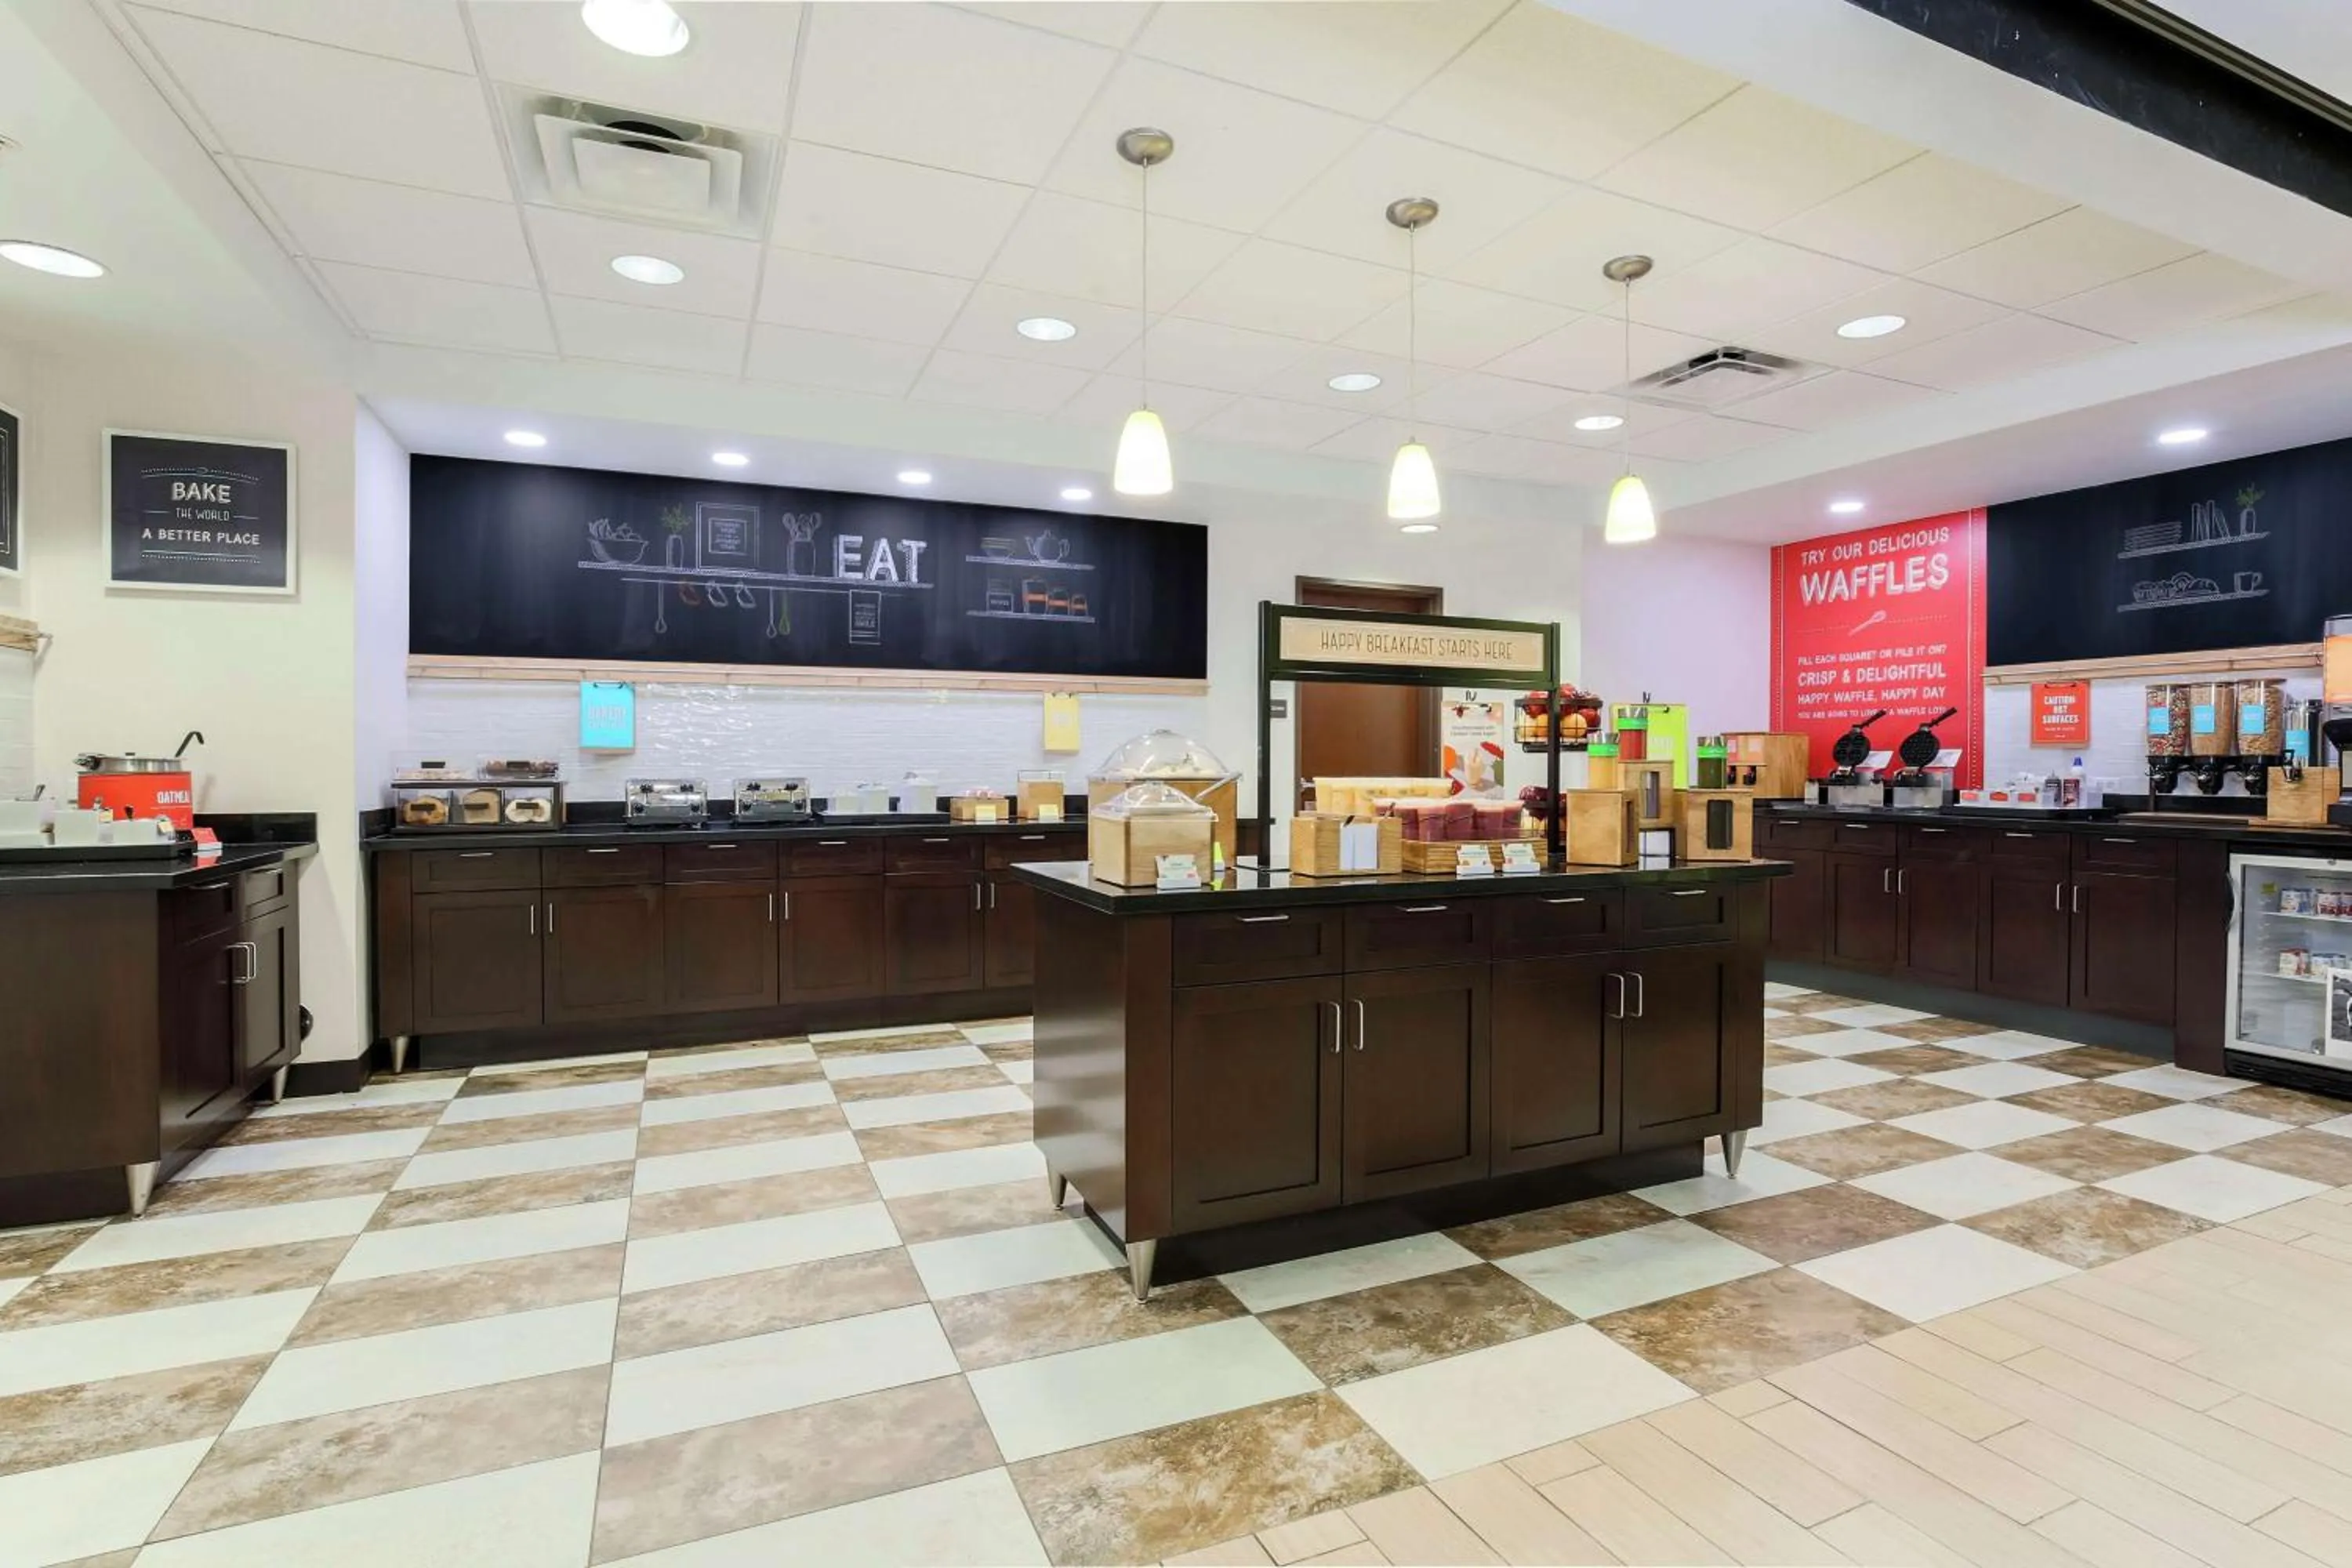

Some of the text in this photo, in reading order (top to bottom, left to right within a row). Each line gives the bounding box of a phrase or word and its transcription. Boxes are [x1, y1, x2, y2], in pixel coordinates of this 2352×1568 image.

[171, 481, 232, 504] BAKE
[176, 507, 230, 521] THE WORLD
[142, 528, 260, 545] A BETTER PLACE
[1801, 527, 1950, 566] TRY OUR DELICIOUS
[833, 534, 927, 584] EAT
[1799, 553, 1950, 607] WAFFLES
[1320, 630, 1513, 660] HAPPY BREAKFAST STARTS HERE
[1798, 656, 1813, 666] FILL
[1815, 654, 1837, 664] EACH
[1879, 648, 1892, 659] OR
[1895, 646, 1915, 658] PILE
[1917, 645, 1926, 655] IT
[1798, 662, 1947, 687] CRISP & DELIGHTFUL
[1798, 691, 1830, 705] HAPPY
[1881, 687, 1918, 700] HAPPY
[1922, 685, 1947, 699] DAY
[2044, 695, 2076, 705] CAUTION
[1896, 706, 1926, 716] WAFFLE
[2042, 714, 2079, 724] SURFACES
[157, 790, 191, 804] OATMEA
